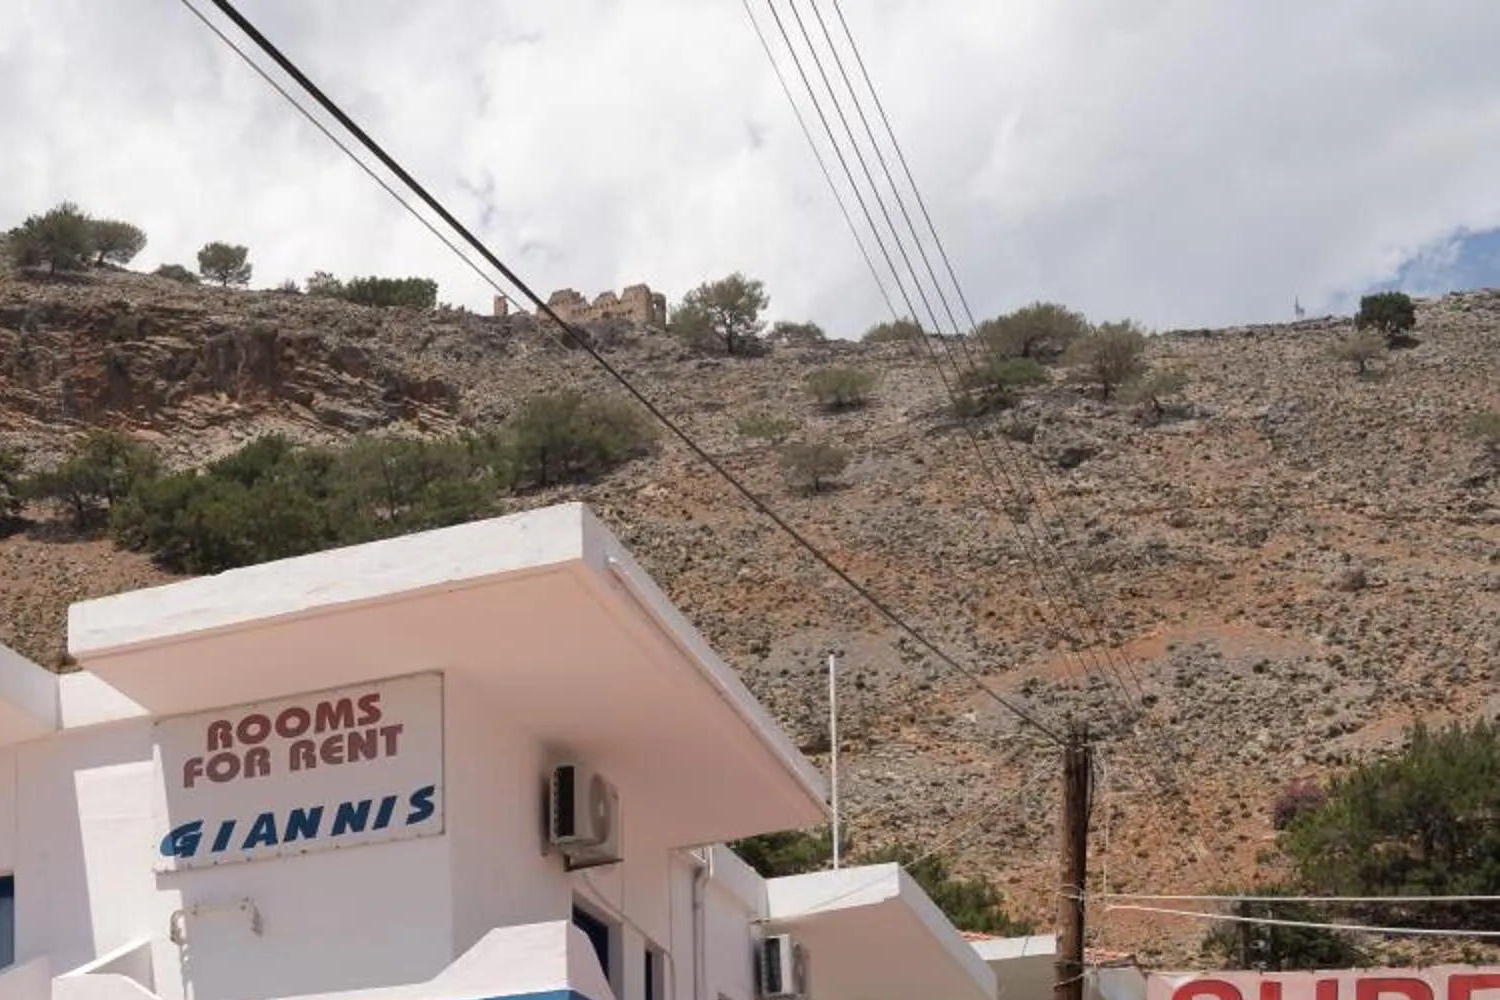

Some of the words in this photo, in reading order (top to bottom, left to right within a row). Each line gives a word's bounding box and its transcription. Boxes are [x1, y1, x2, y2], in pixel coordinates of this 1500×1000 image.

[207, 694, 383, 751] ROOMS
[183, 747, 271, 788] FOR
[289, 724, 404, 771] RENT
[159, 785, 436, 858] GIANNIS
